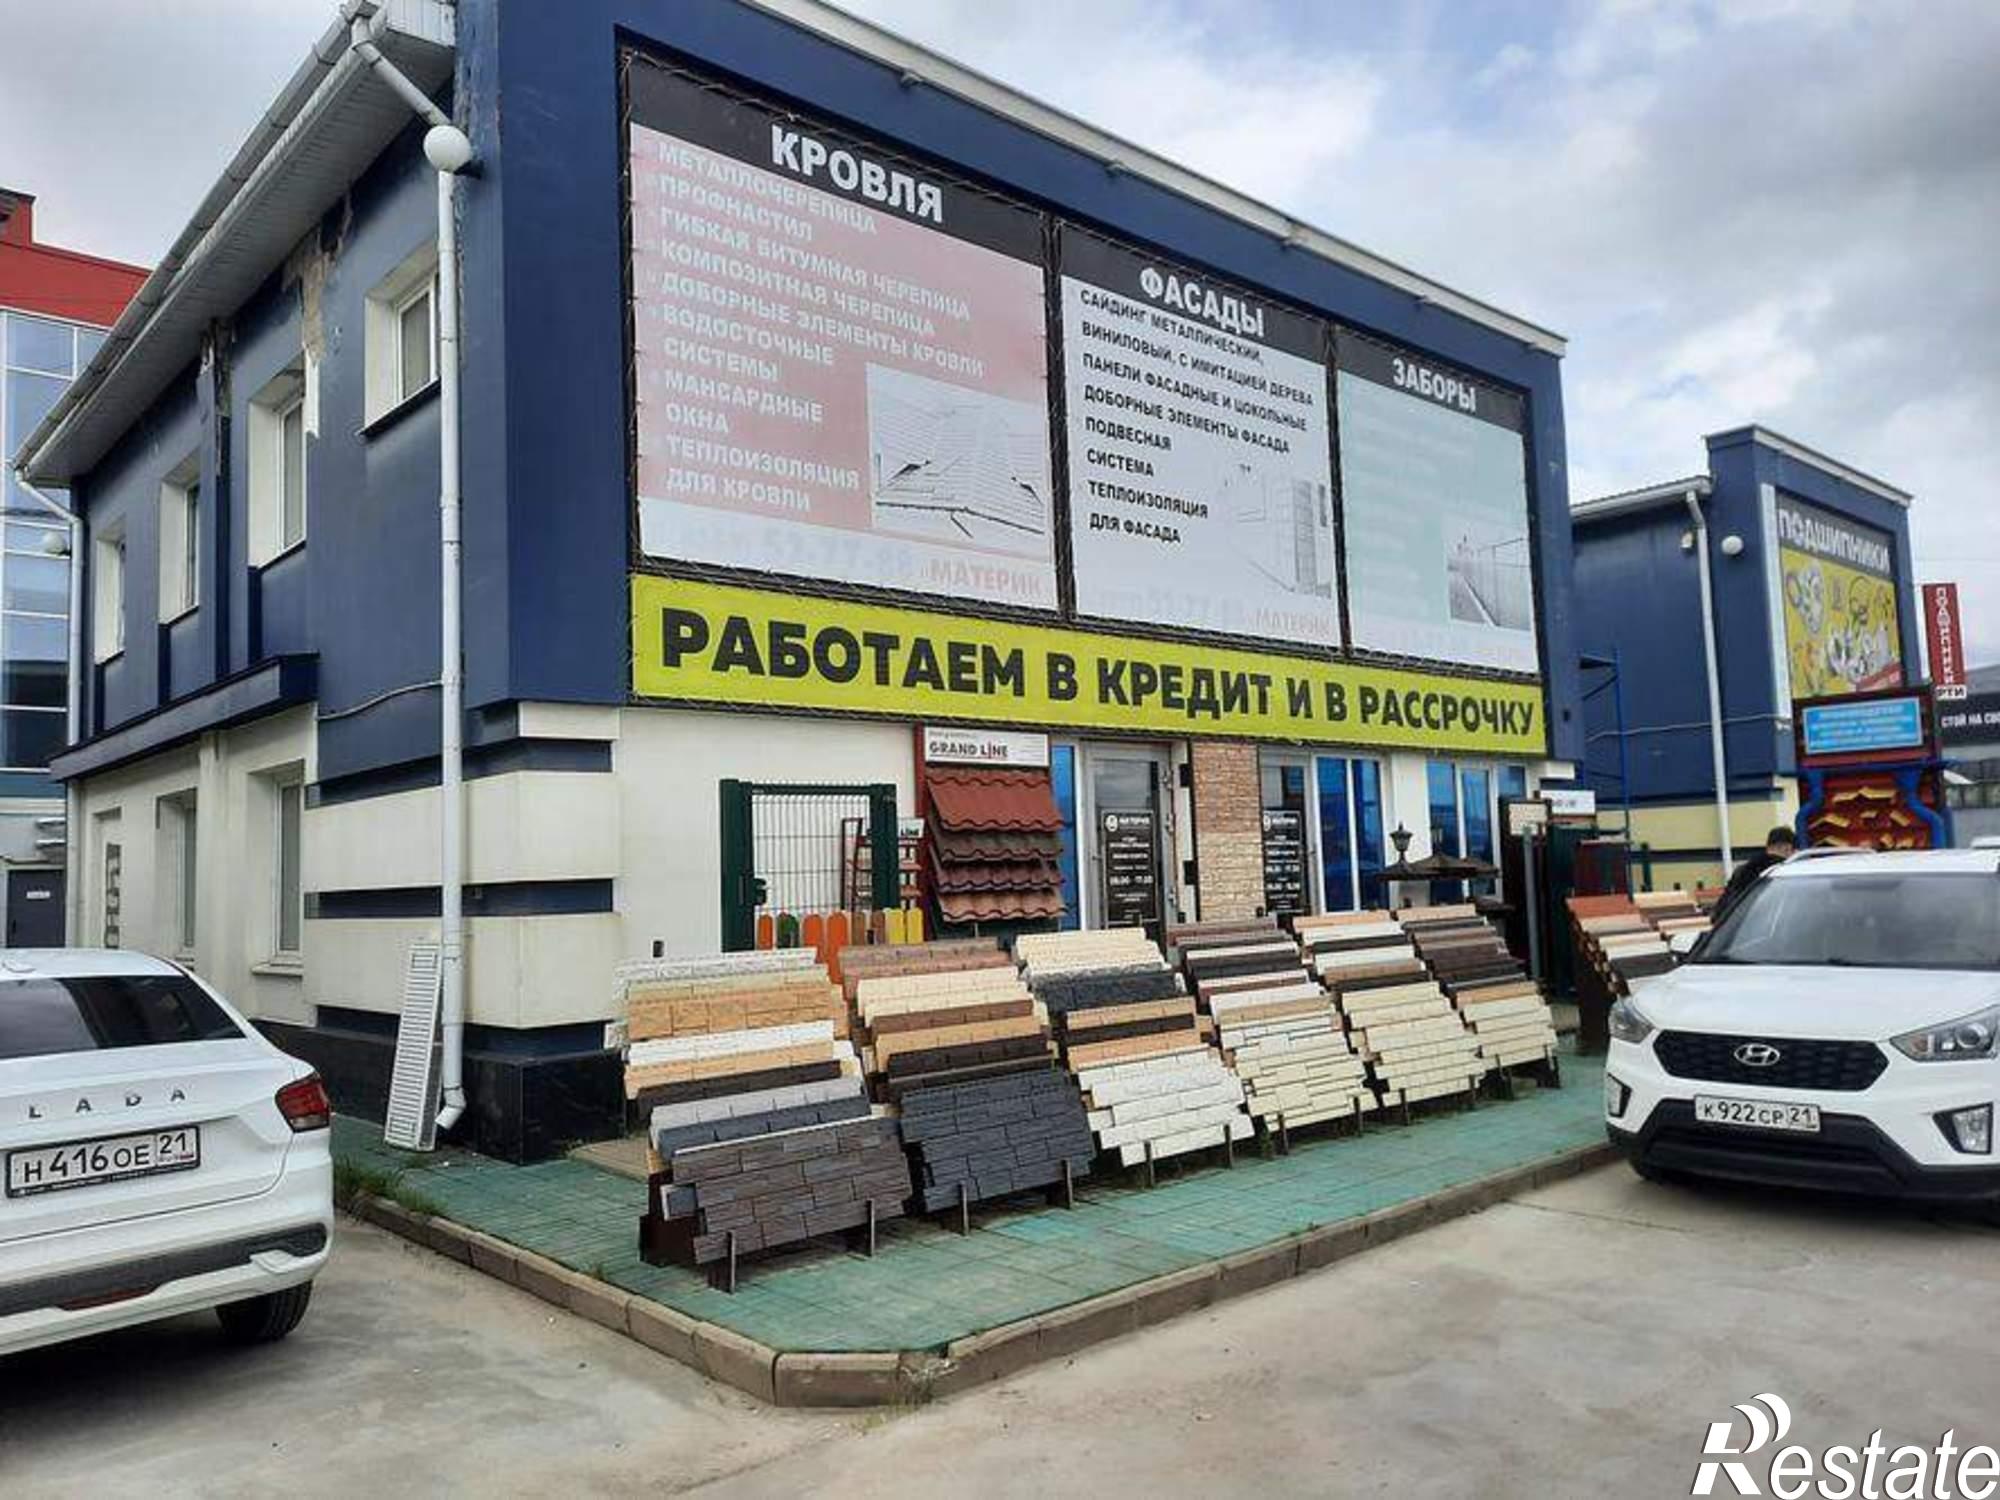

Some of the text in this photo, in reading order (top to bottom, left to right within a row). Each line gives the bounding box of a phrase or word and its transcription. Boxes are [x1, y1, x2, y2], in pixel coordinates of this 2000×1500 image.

[658, 141, 878, 236] МЕТАЛЛОЧЕРЕПИЦА
[771, 124, 943, 224] КРОВЛЯ
[661, 174, 813, 241] ПРОФНАСТИЛ
[660, 207, 970, 321] ГИБКАЯ БИТУМНАЯ ЧЕРЕПИЦА
[660, 239, 935, 337] КОМПОЗИТНАЯ ЧЕРЕПИЦА
[660, 272, 985, 378] ДОБОРНЫЕ ЭЛЕМЕНТЫ КРОВЛИ
[1080, 289, 1148, 323] САЙДИНГ
[1140, 267, 1264, 337] ФАСАДЫ
[662, 303, 835, 366] ВОДОСТОЧНЫЕ
[663, 337, 779, 381] СИСТЕМЫ
[1082, 320, 1313, 406] ВИНИЛОВЫЙ, С ИМИТАЦИЕЙ ДЕРЕВА
[1392, 358, 1477, 413] ЗАБОРЫ
[664, 369, 824, 422] МАНСАРДНЫЕ
[666, 403, 730, 434] ОКНА
[1082, 352, 1307, 432] ПАНЕЛИ ФАСАДНЫЕ И ЦОКОЛЬНЫЕ
[1084, 384, 1290, 453] ДОБОРНЫЕ ЭЛЕМЕНТЫ ФАСАДА
[666, 433, 860, 489] ТЕПЛОИЗОЛЯЦИЯ
[1086, 416, 1172, 451] ПОДВЕСНАЯ
[665, 467, 811, 510] ДЛЯ КРОВЛИ
[1087, 449, 1154, 476] СИСТЕМА
[1088, 480, 1209, 519] ТЕПЛОИЗОЛЯЦИЯ
[1089, 512, 1181, 543] ДЛЯ ФАСАДА
[661, 606, 1535, 736] РАБОТАЕМ В КРЕДИТ И В РАССРОЧКУ
[929, 741, 979, 757] GRAND
[980, 741, 1008, 759] LINE
[28, 1088, 187, 1119] LADA
[1704, 1101, 1813, 1125] К922СР 21
[24, 1143, 150, 1184] Н416ОЕ
[159, 1132, 187, 1155] 21
